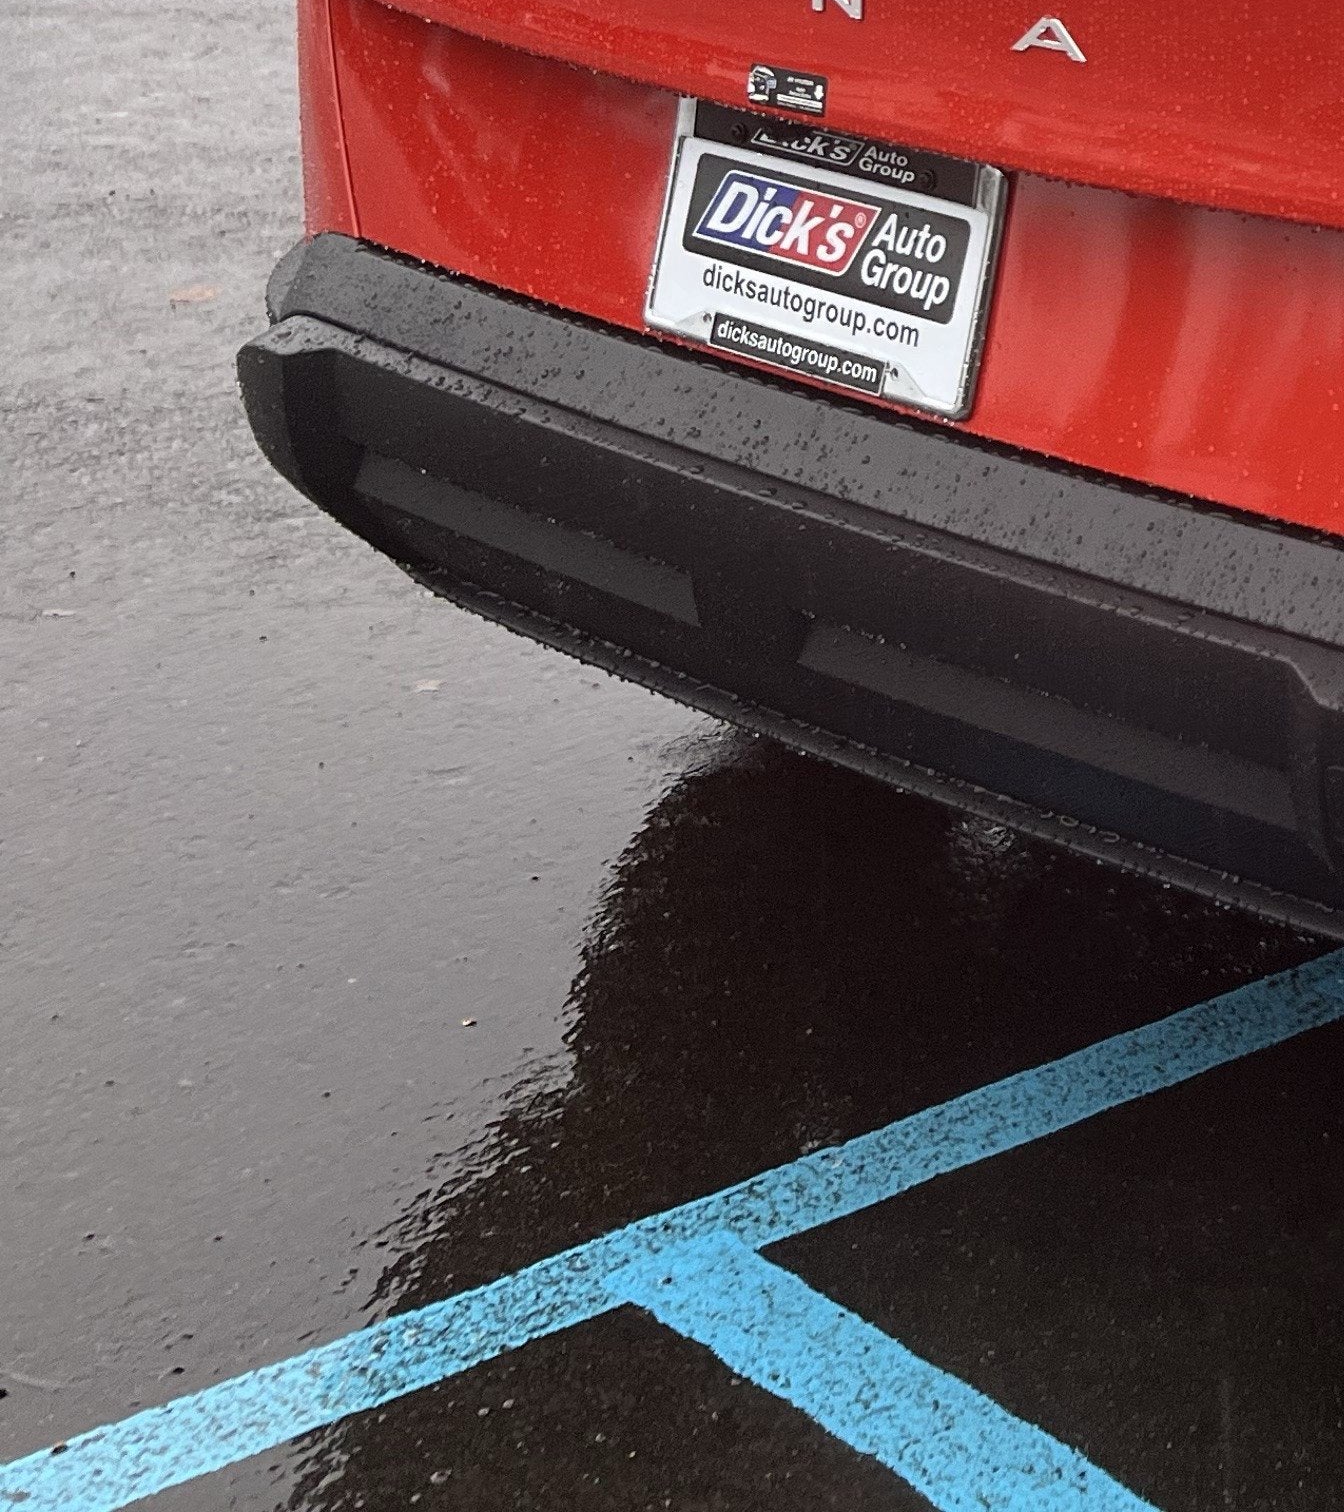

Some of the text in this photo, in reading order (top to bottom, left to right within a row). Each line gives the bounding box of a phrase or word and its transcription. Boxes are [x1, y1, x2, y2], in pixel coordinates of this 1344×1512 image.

[858, 157, 916, 184] Group
[864, 145, 909, 167] Auto
[871, 213, 948, 264] Auto
[702, 263, 920, 347] dicksautogroup.com
[860, 248, 951, 312] Group
[717, 321, 878, 384] dicksautogroup.com
